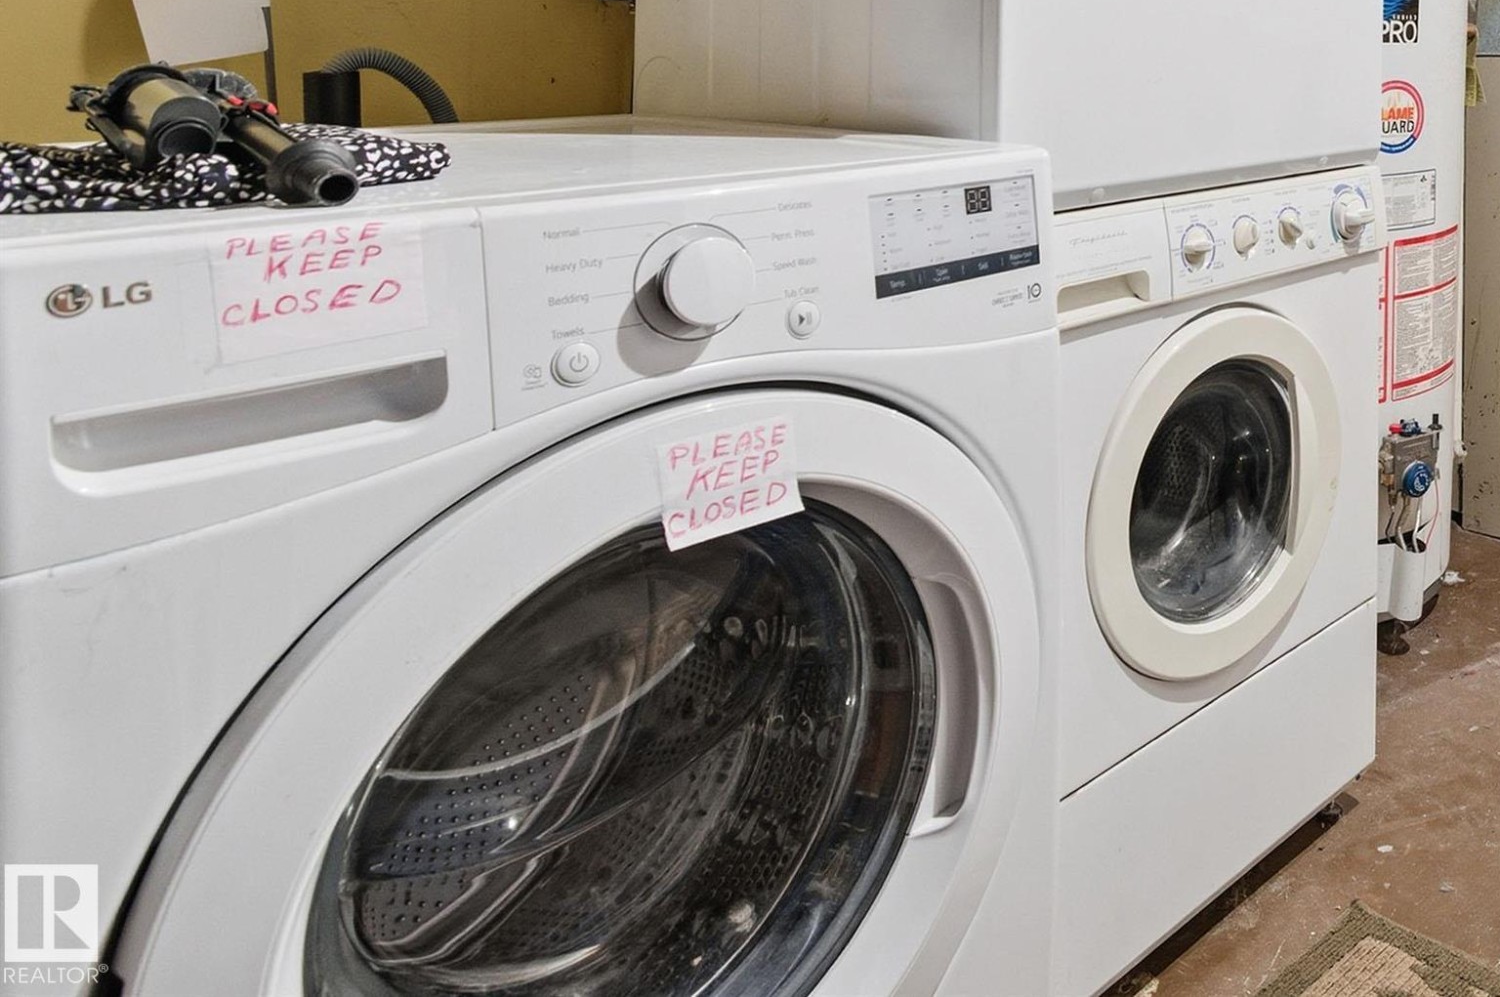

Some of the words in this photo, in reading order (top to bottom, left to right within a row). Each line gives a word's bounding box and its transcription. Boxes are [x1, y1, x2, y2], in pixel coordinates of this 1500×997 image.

[1382, 107, 1414, 121] LAME
[1382, 120, 1415, 134] UARD
[226, 221, 388, 259] PLEASE
[263, 245, 382, 283] KEEP
[545, 263, 577, 275] Heavy
[579, 258, 603, 271] Duty
[102, 281, 152, 308] LG
[221, 279, 401, 327] CLOSED
[548, 293, 589, 307] Bedding
[552, 327, 585, 340] Towels
[670, 424, 787, 470] PLEASE
[686, 450, 779, 500] KEEP
[668, 482, 787, 538] CLOSED
